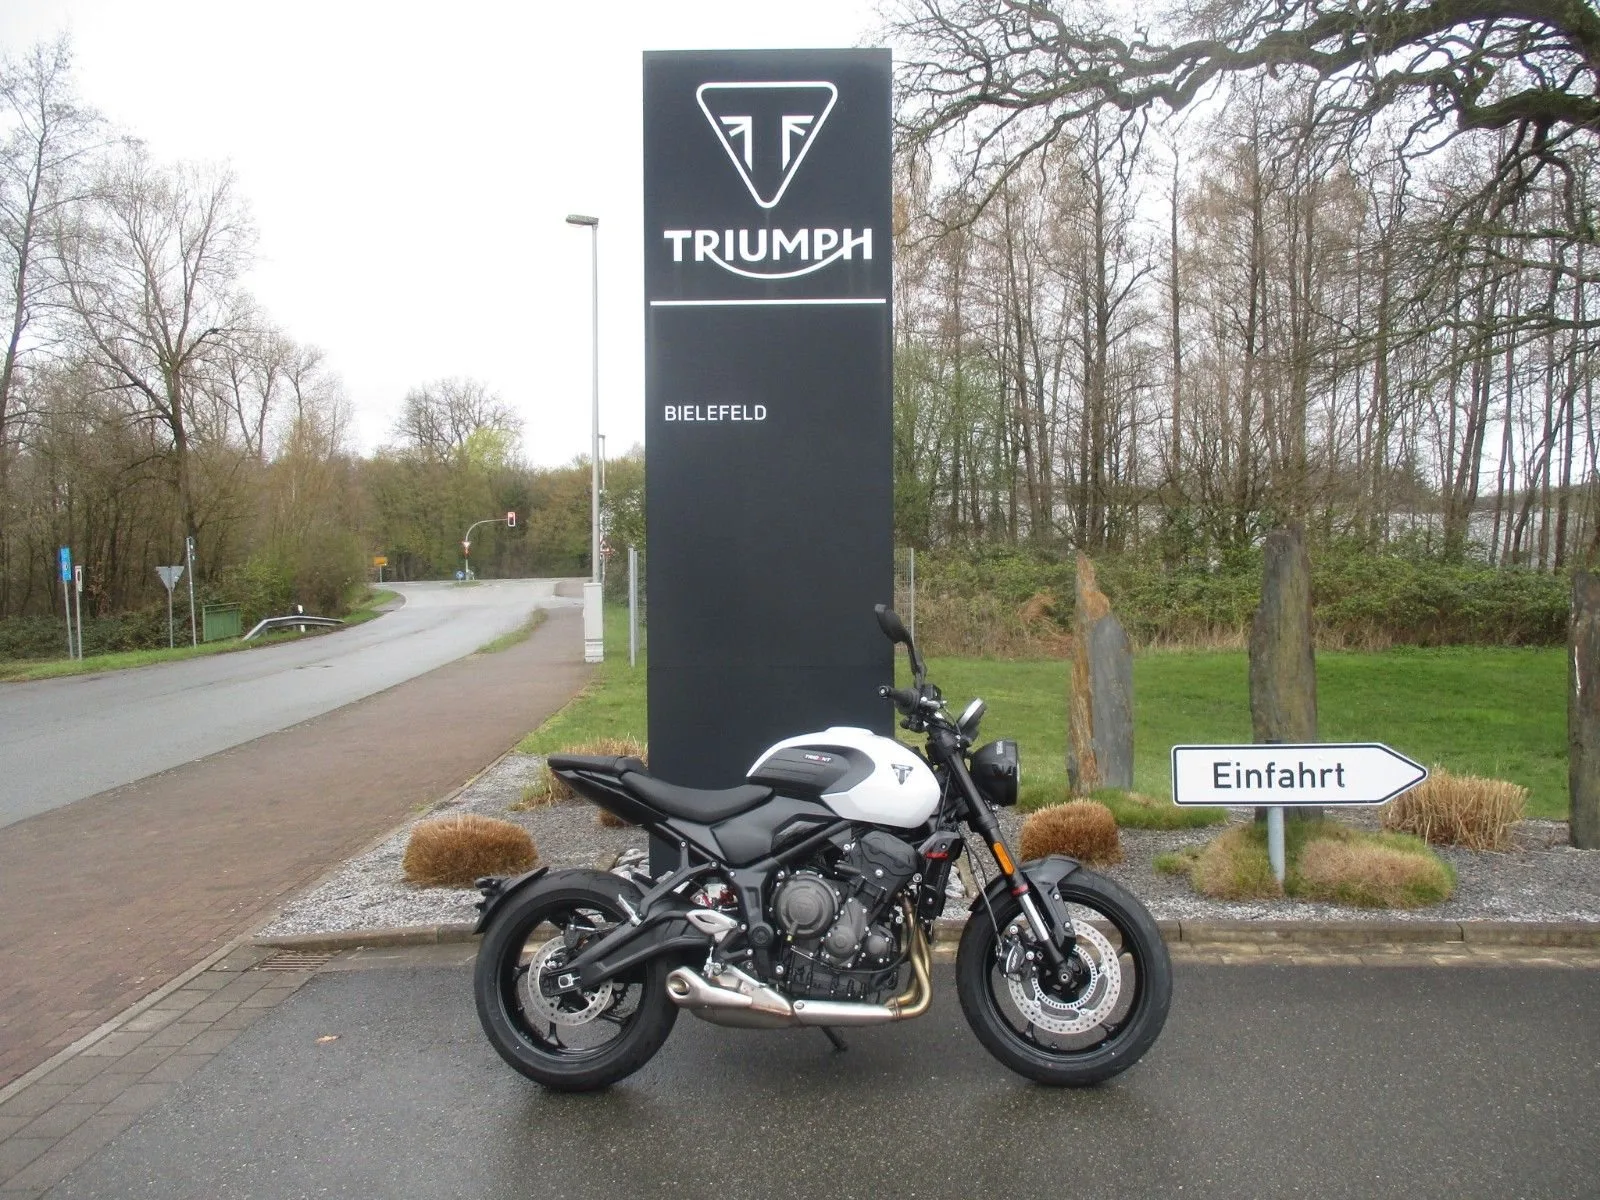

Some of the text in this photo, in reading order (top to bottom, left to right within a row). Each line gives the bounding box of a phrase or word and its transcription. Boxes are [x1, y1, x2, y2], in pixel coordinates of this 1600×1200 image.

[664, 228, 873, 279] TRIUMPH
[664, 404, 767, 421] BIELEFELD
[1213, 762, 1345, 788] Einfahrt
